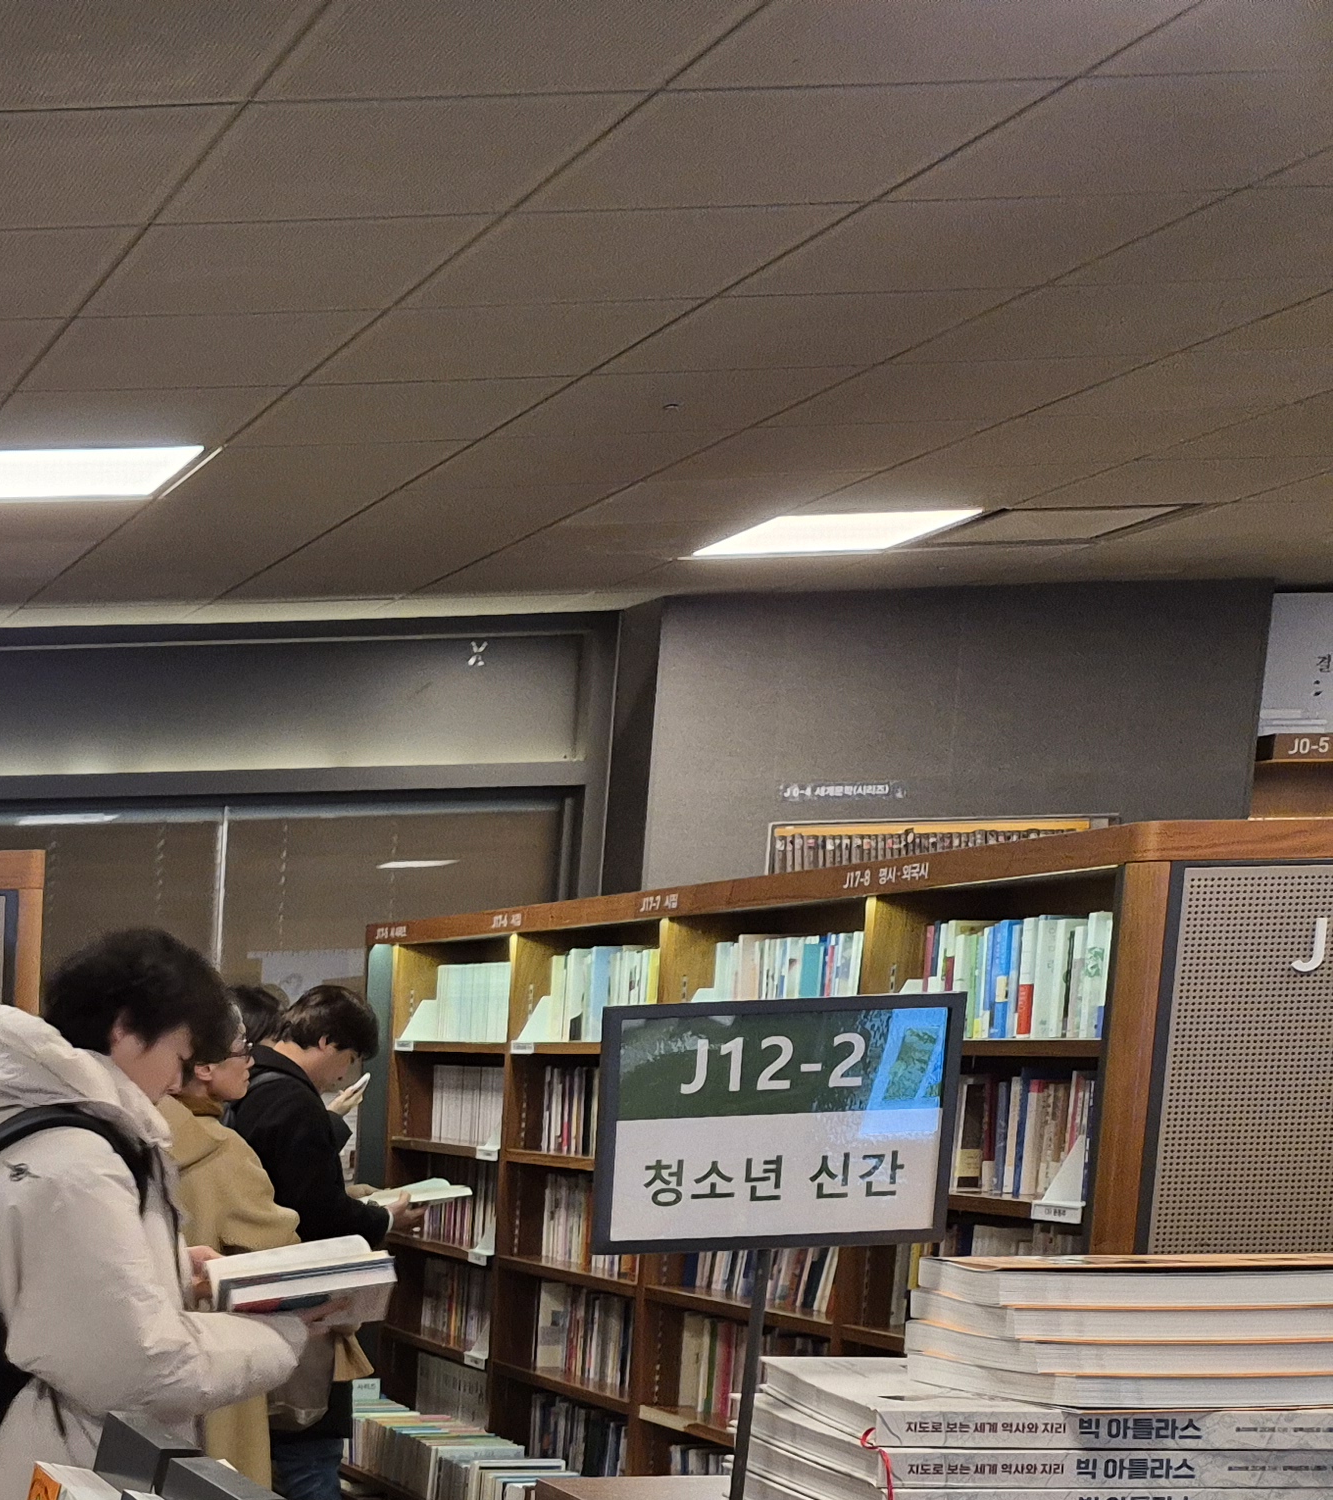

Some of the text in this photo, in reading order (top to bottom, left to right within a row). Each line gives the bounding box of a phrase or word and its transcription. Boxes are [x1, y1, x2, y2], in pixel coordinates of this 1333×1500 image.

[843, 869, 871, 889] J17-8
[680, 1031, 865, 1096] J12-2
[642, 1152, 906, 1207] 청소년 신간
[906, 1418, 1203, 1440] 지도로 보는 세계 역사와 지리 빅 아틀라스
[907, 1458, 1196, 1480] 지도로 보는 세계 역사와 지리 빅 아틀라스
